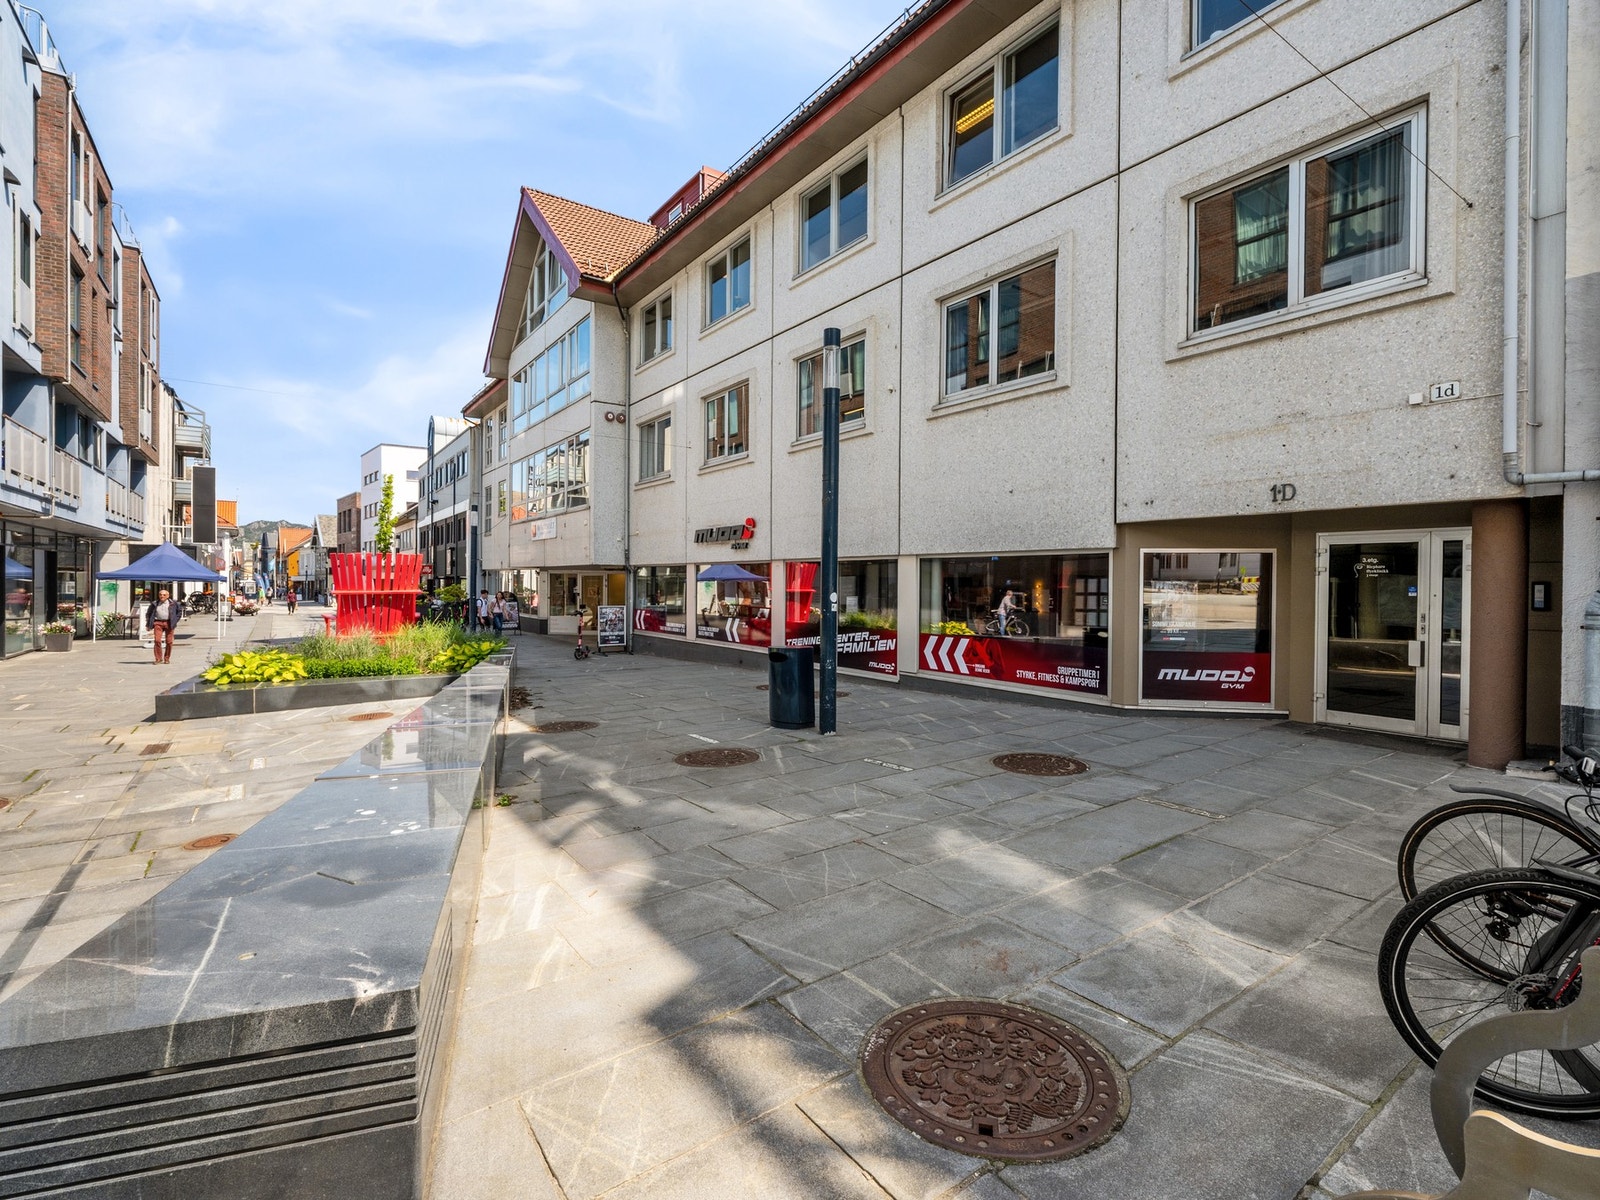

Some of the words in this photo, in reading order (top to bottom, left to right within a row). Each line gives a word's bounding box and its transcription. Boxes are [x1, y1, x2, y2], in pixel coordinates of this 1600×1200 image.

[1435, 384, 1456, 399] 1d
[837, 638, 897, 654] FAMILIEN
[1038, 672, 1060, 683] FITNESS
[1065, 676, 1100, 689] KAMPSPORT
[1057, 666, 1097, 680] GRUPPETIMER
[1157, 668, 1241, 682] MUDO
